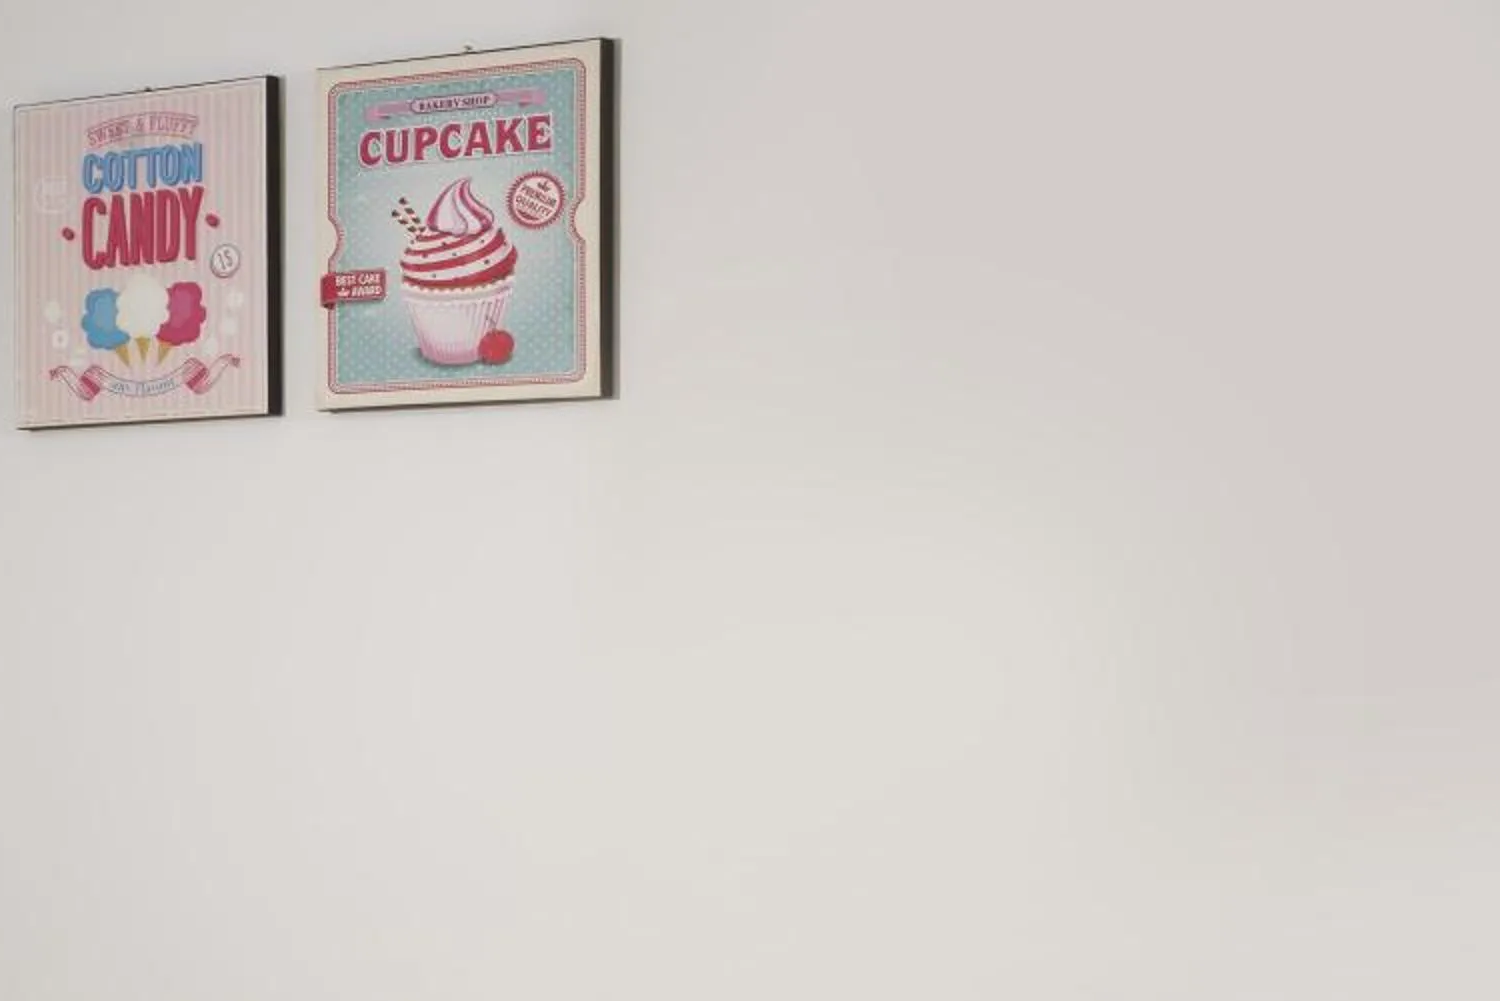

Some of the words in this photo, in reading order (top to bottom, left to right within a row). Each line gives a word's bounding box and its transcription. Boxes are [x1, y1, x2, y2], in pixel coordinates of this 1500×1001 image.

[462, 95, 491, 107] SHOP
[359, 113, 554, 167] CUPCAKE
[82, 143, 203, 193] COTTON
[82, 186, 204, 270] CANDY
